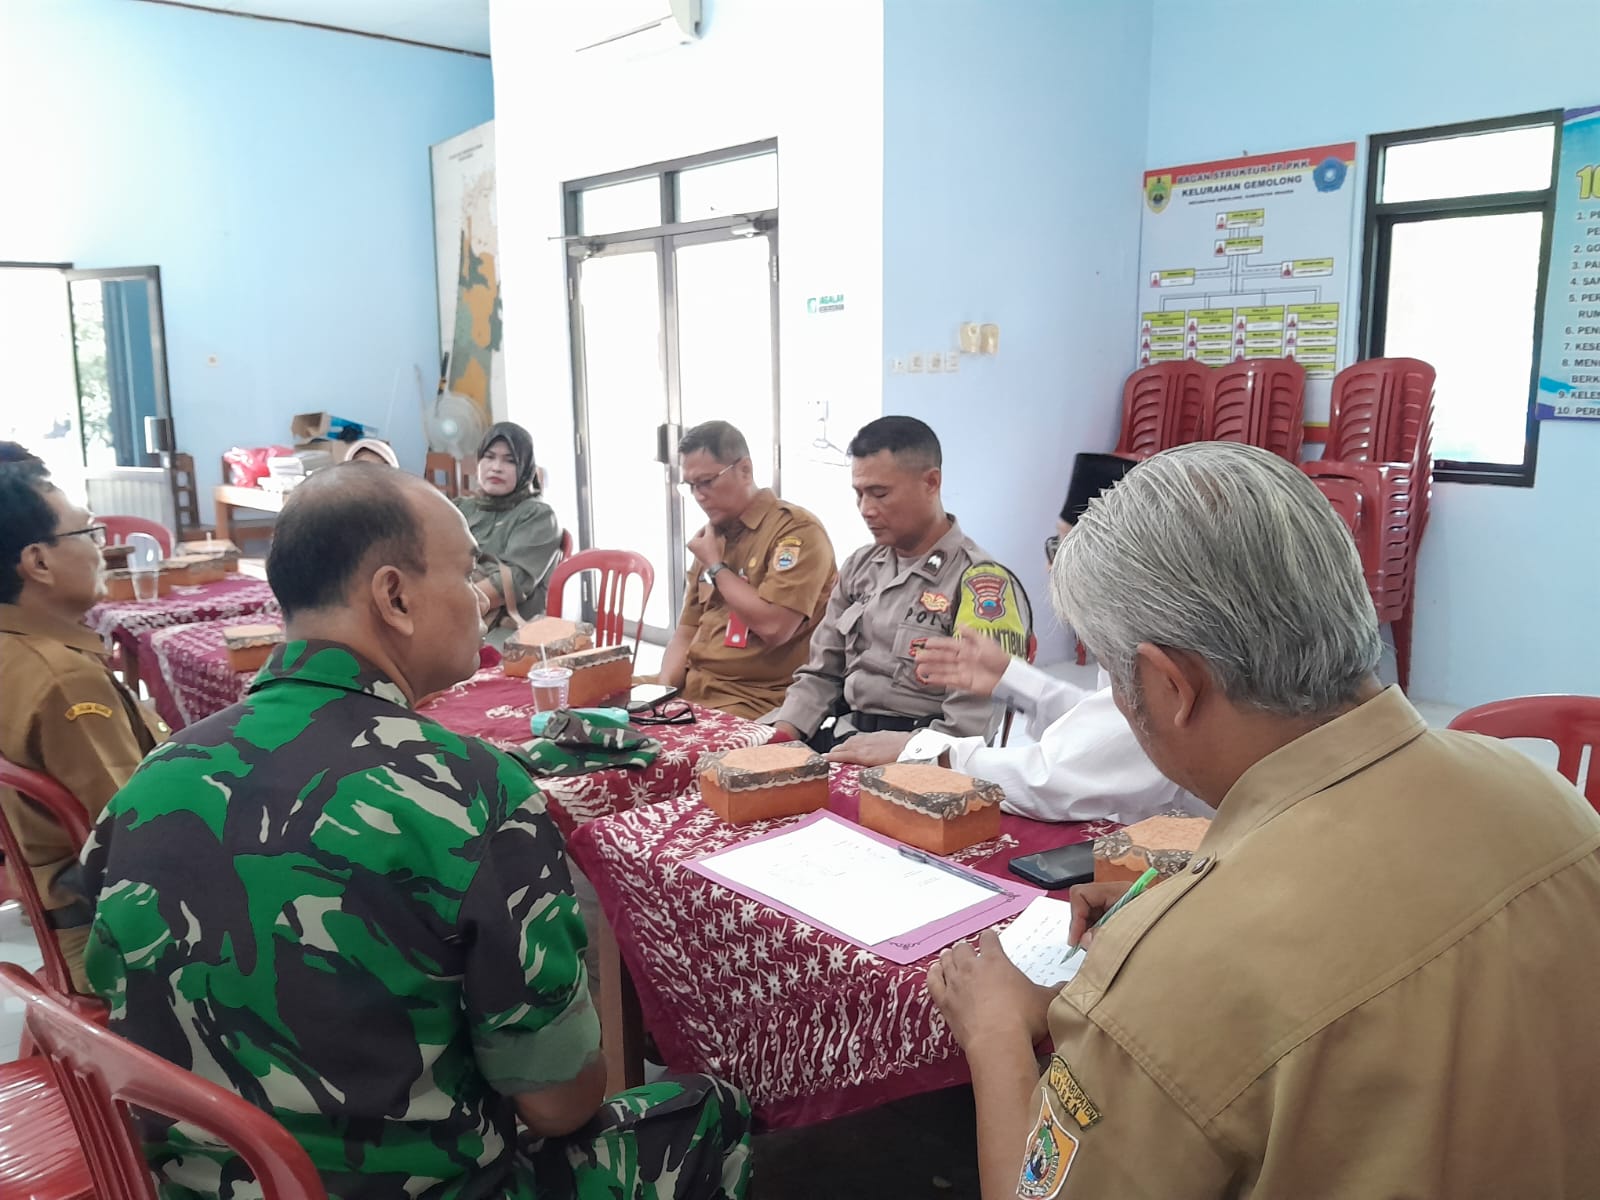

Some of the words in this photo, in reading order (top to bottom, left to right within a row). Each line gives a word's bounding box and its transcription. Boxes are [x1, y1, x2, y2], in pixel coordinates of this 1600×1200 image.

[1213, 166, 1269, 180] STRUKTUR
[1286, 160, 1310, 170] PKK
[1182, 183, 1241, 197] KELURAHAN
[1243, 174, 1303, 190] GEMOLONG
